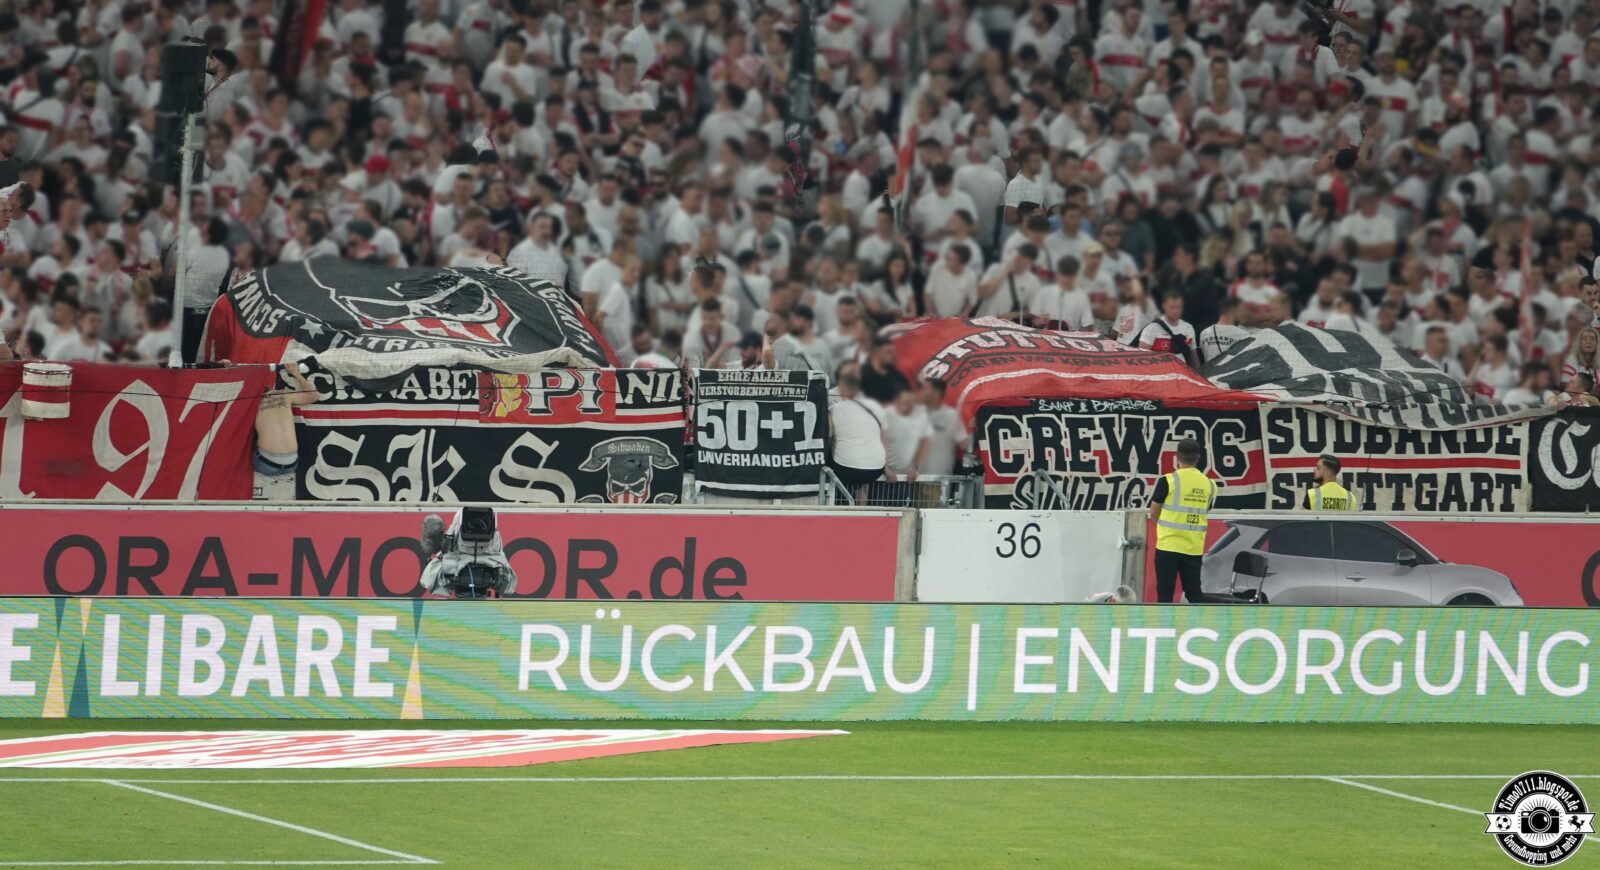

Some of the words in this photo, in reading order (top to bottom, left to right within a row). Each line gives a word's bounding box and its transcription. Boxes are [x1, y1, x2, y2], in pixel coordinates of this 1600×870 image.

[699, 386, 771, 397] VERSTORBENEN
[718, 371, 751, 382] EHRE
[751, 371, 790, 383] ALLEN
[697, 401, 825, 451] 50+1
[1271, 472, 1522, 511] STTTGART
[1322, 497, 1347, 511] SECURITY
[995, 522, 1042, 559] 36
[43, 534, 748, 600] ORA-MOOR.de
[100, 614, 397, 697] LIBARE
[518, 608, 935, 693] RÜCKBAU
[1013, 626, 1591, 698] ENTSORGUNG
